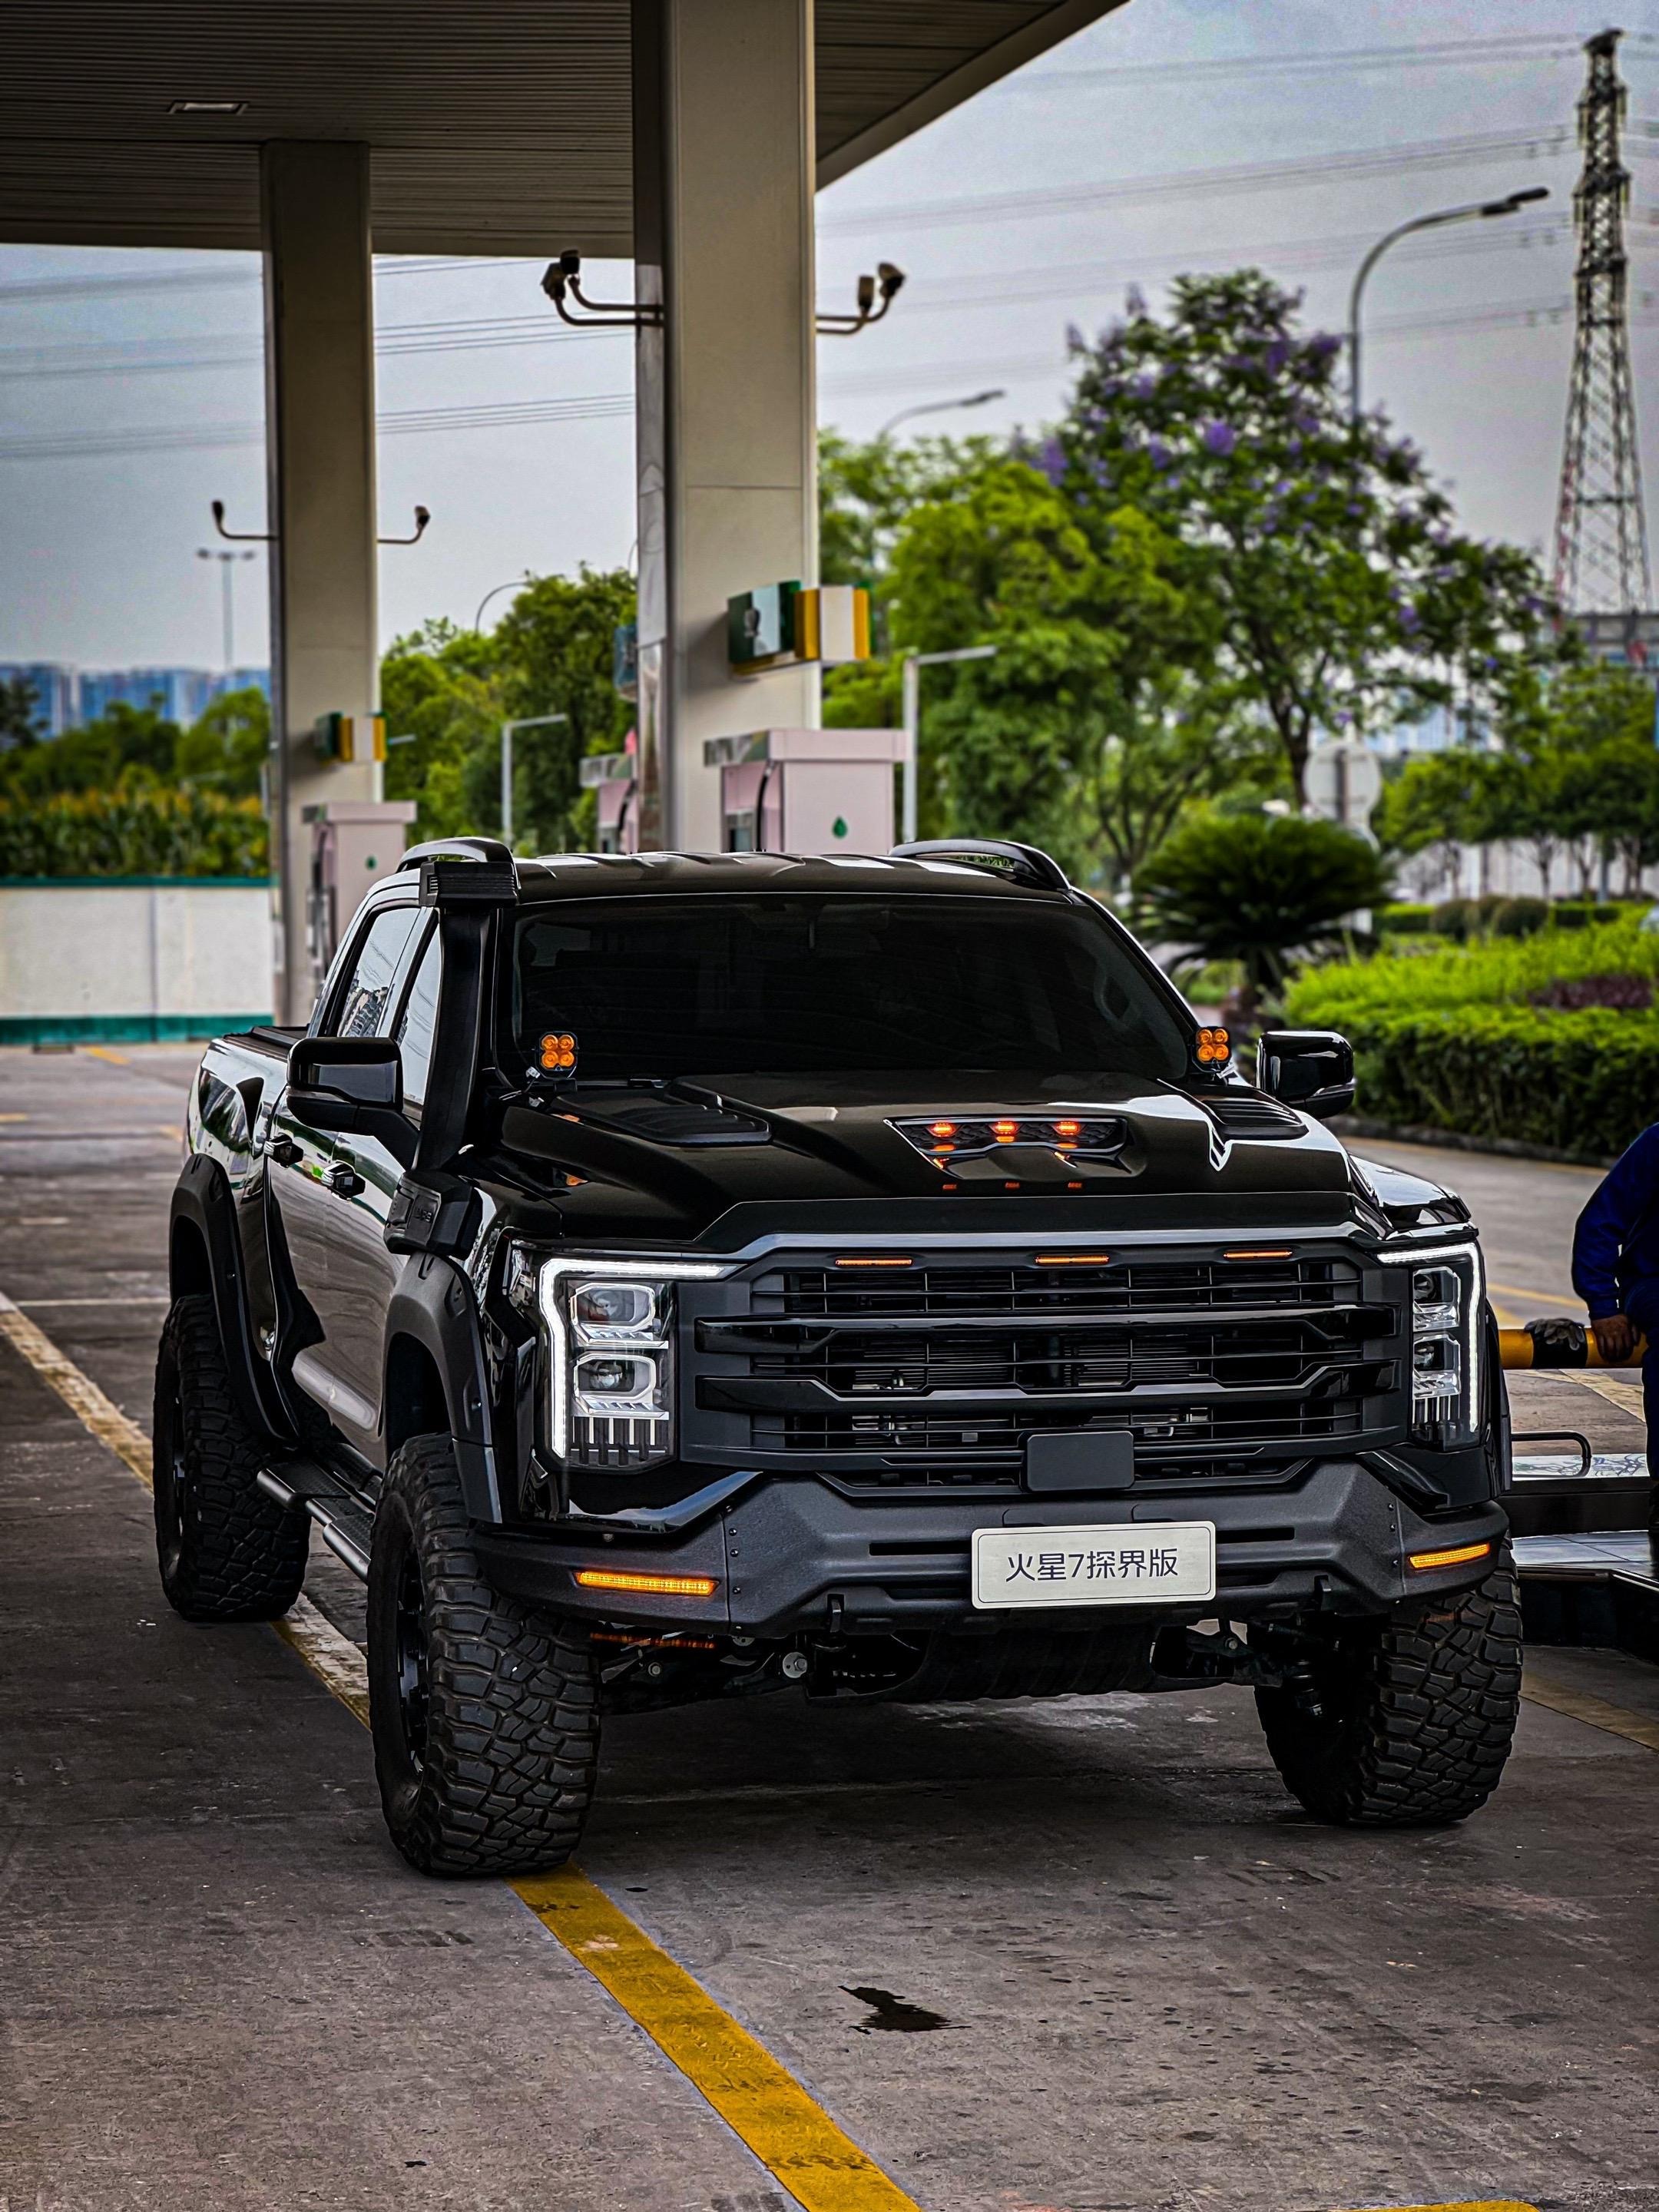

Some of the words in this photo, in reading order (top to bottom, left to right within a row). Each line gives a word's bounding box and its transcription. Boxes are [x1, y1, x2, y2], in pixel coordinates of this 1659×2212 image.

[1005, 1548, 1178, 1582] 火星7探界版
